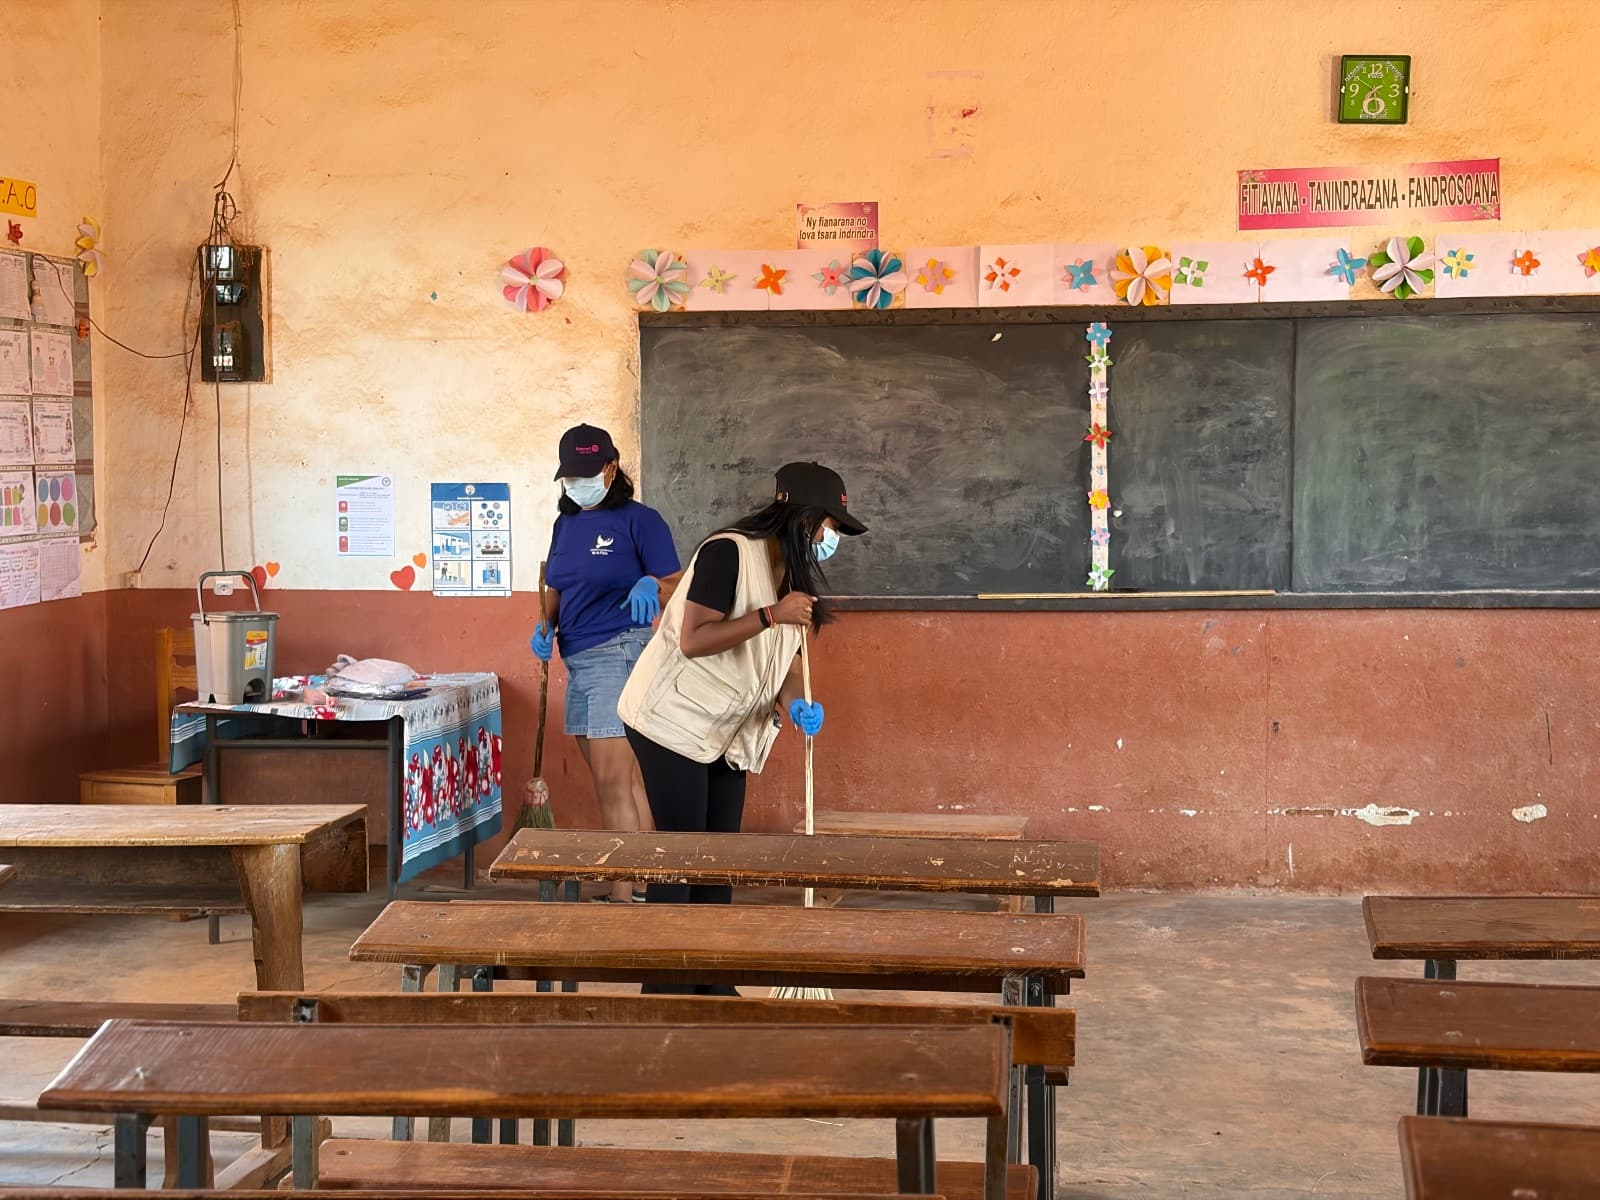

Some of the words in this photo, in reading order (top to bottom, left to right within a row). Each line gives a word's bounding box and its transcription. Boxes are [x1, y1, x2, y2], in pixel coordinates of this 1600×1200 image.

[1369, 63, 1383, 74] 12
[1349, 83, 1359, 98] 9
[1388, 84, 1400, 98] 3
[1362, 85, 1385, 116] 6
[1241, 183, 1300, 215] FITIAVANA
[1308, 178, 1399, 212] TANINDRAZANA
[1408, 173, 1499, 209] FANDROSOANA
[806, 216, 817, 230] Ny
[818, 216, 855, 227] fianarana
[856, 217, 867, 226] no
[799, 229, 815, 240] lova
[817, 230, 837, 240] tsara
[838, 228, 874, 240] indrindra
